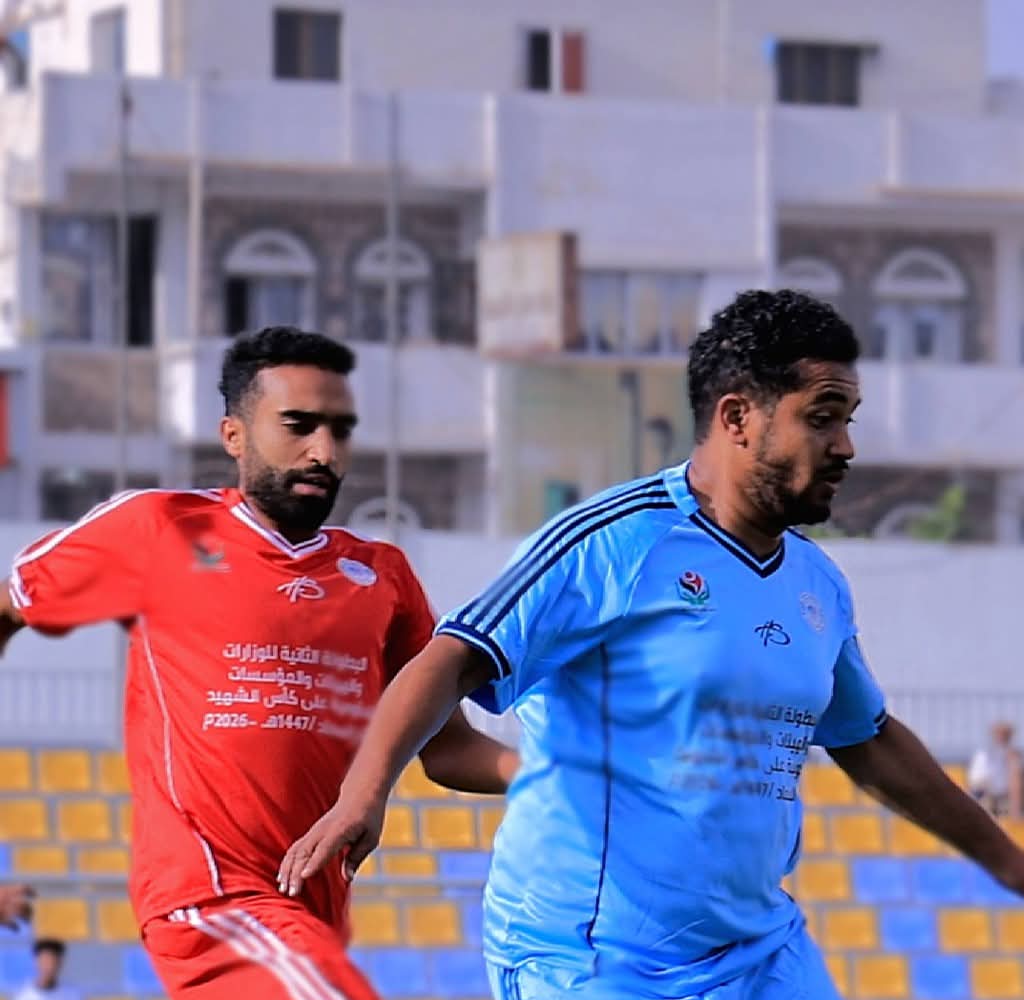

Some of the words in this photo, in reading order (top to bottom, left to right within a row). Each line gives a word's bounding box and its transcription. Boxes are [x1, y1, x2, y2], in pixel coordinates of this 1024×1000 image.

[223, 643, 277, 661] للوزارات
[228, 666, 312, 689] والمؤسسات
[207, 686, 261, 705] الشهيد
[263, 687, 299, 708] كأس
